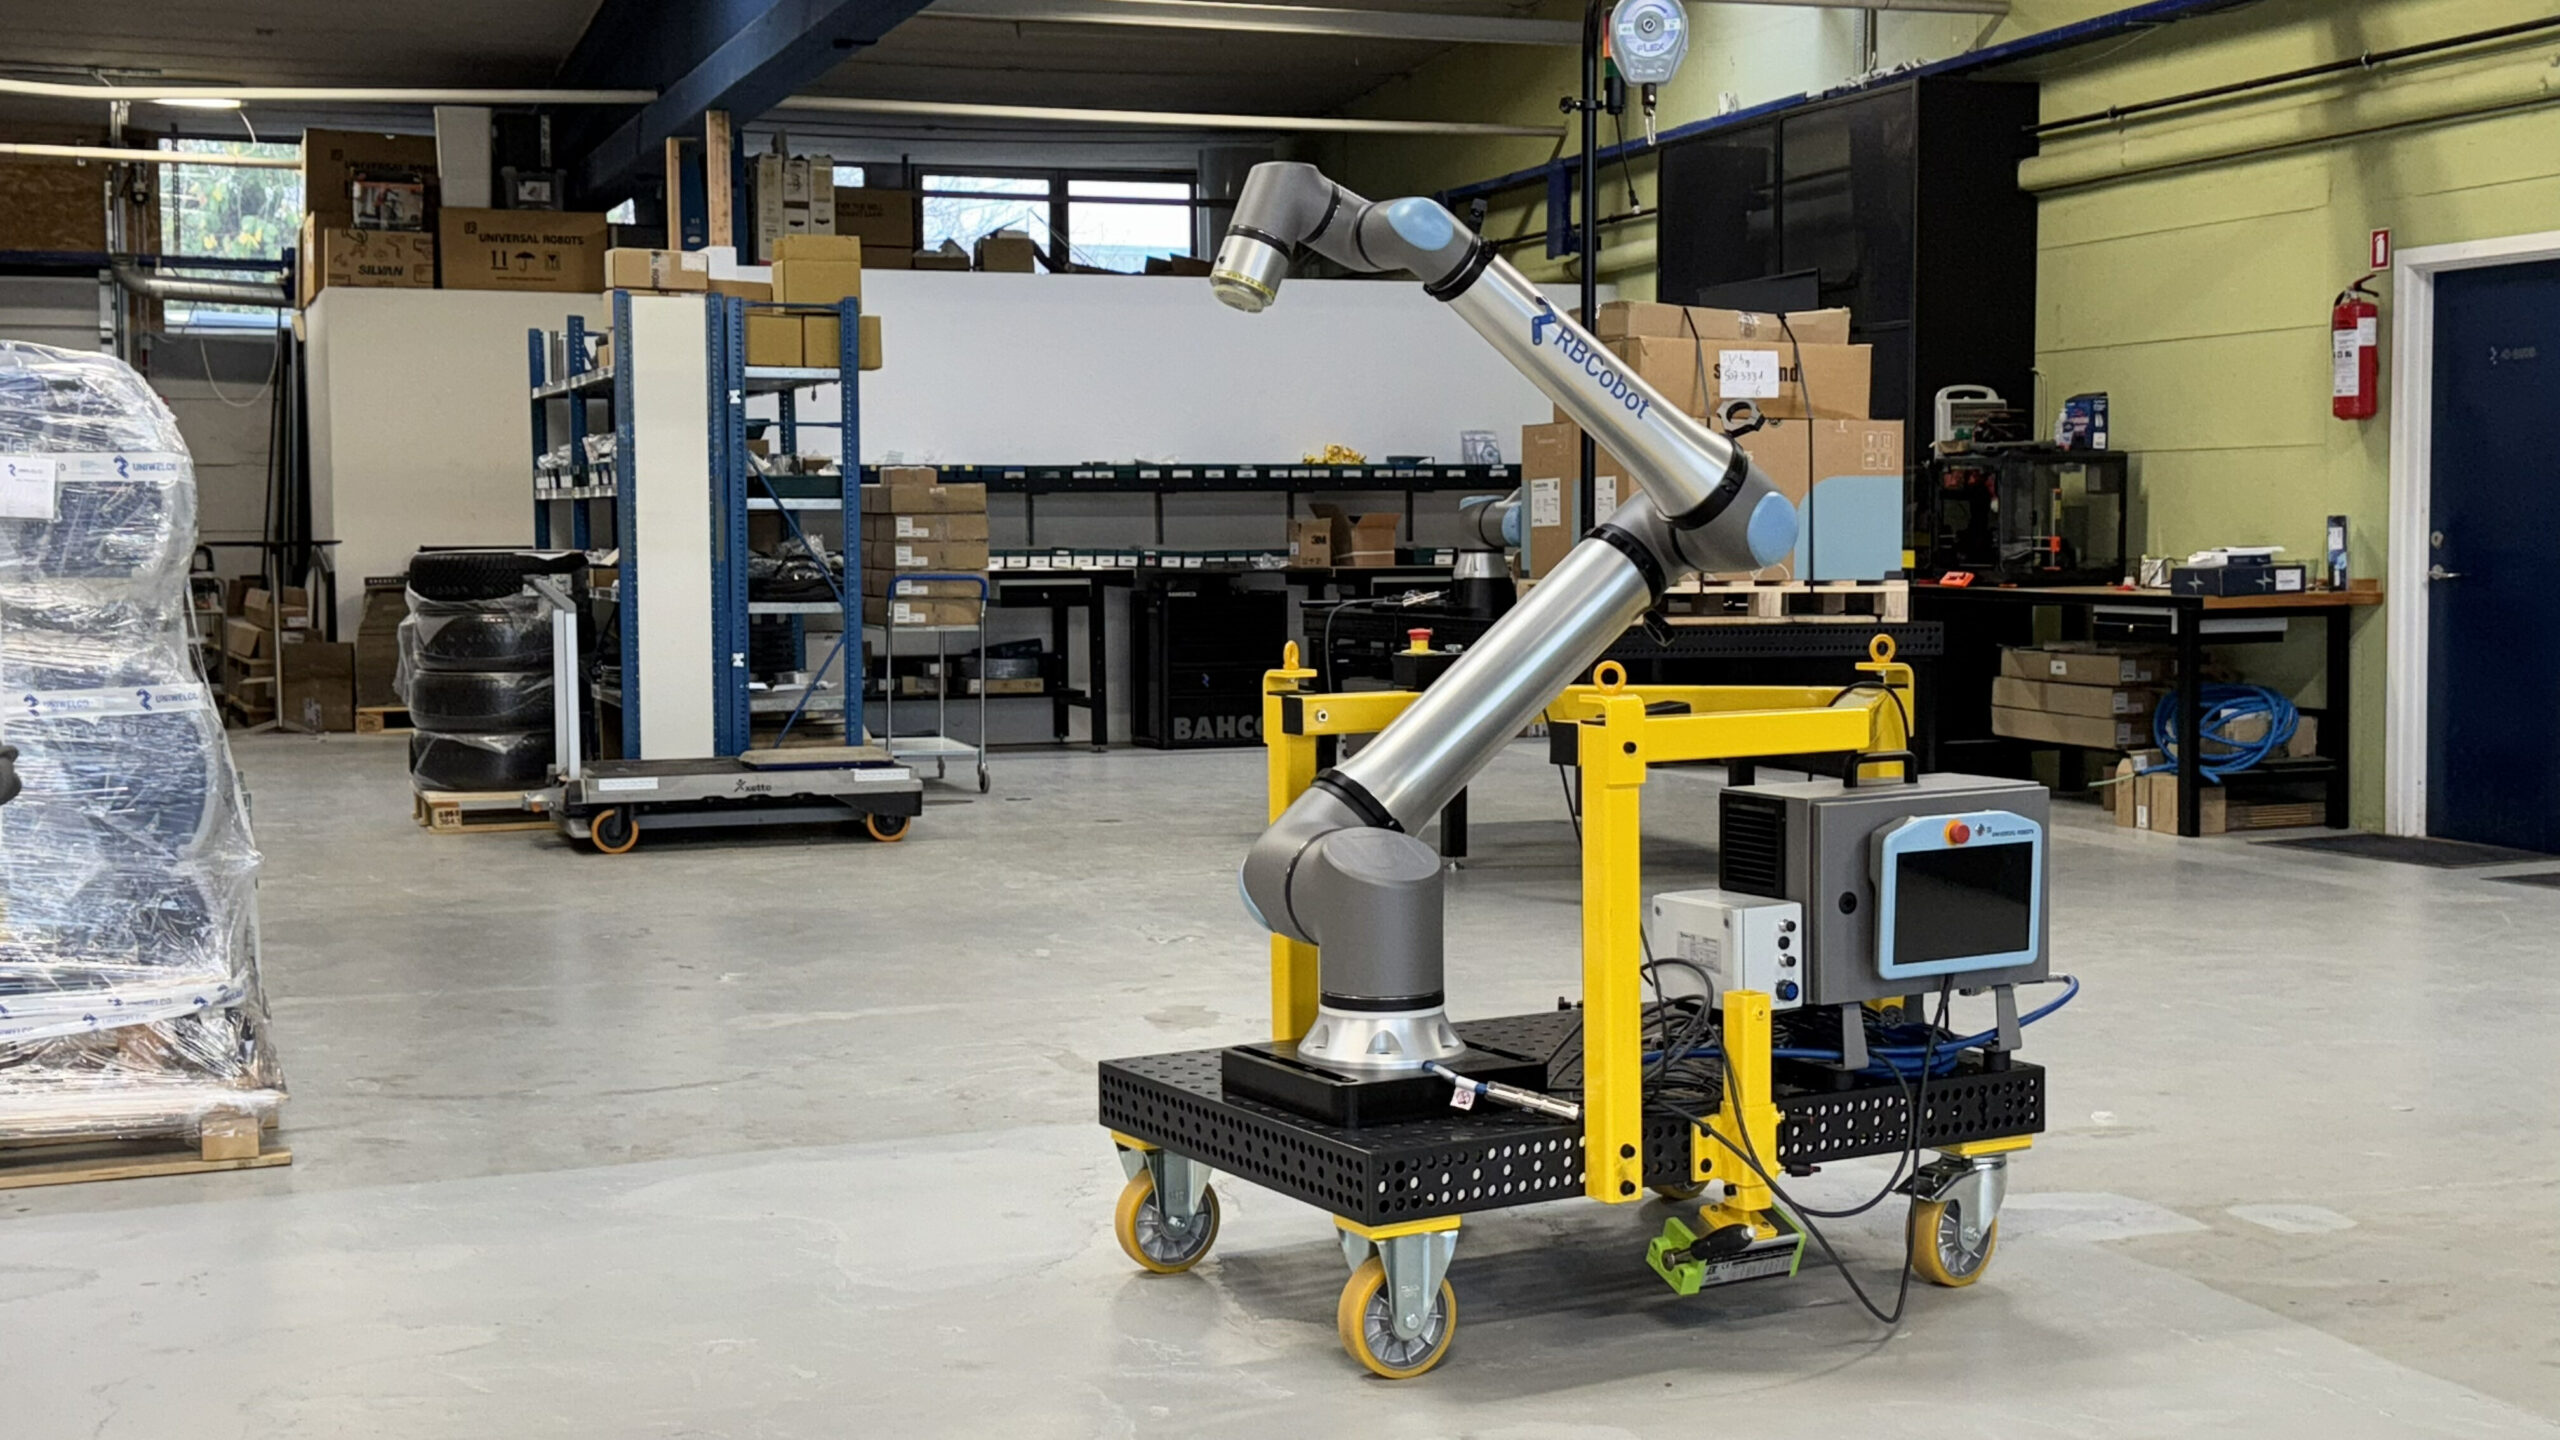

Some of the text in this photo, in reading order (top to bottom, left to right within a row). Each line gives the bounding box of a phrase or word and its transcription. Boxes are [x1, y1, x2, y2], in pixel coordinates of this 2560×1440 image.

[479, 233, 584, 245] UNIVERSAL ROBOTS
[358, 265, 404, 276] SILVAN
[1554, 326, 1650, 420] RBCobot
